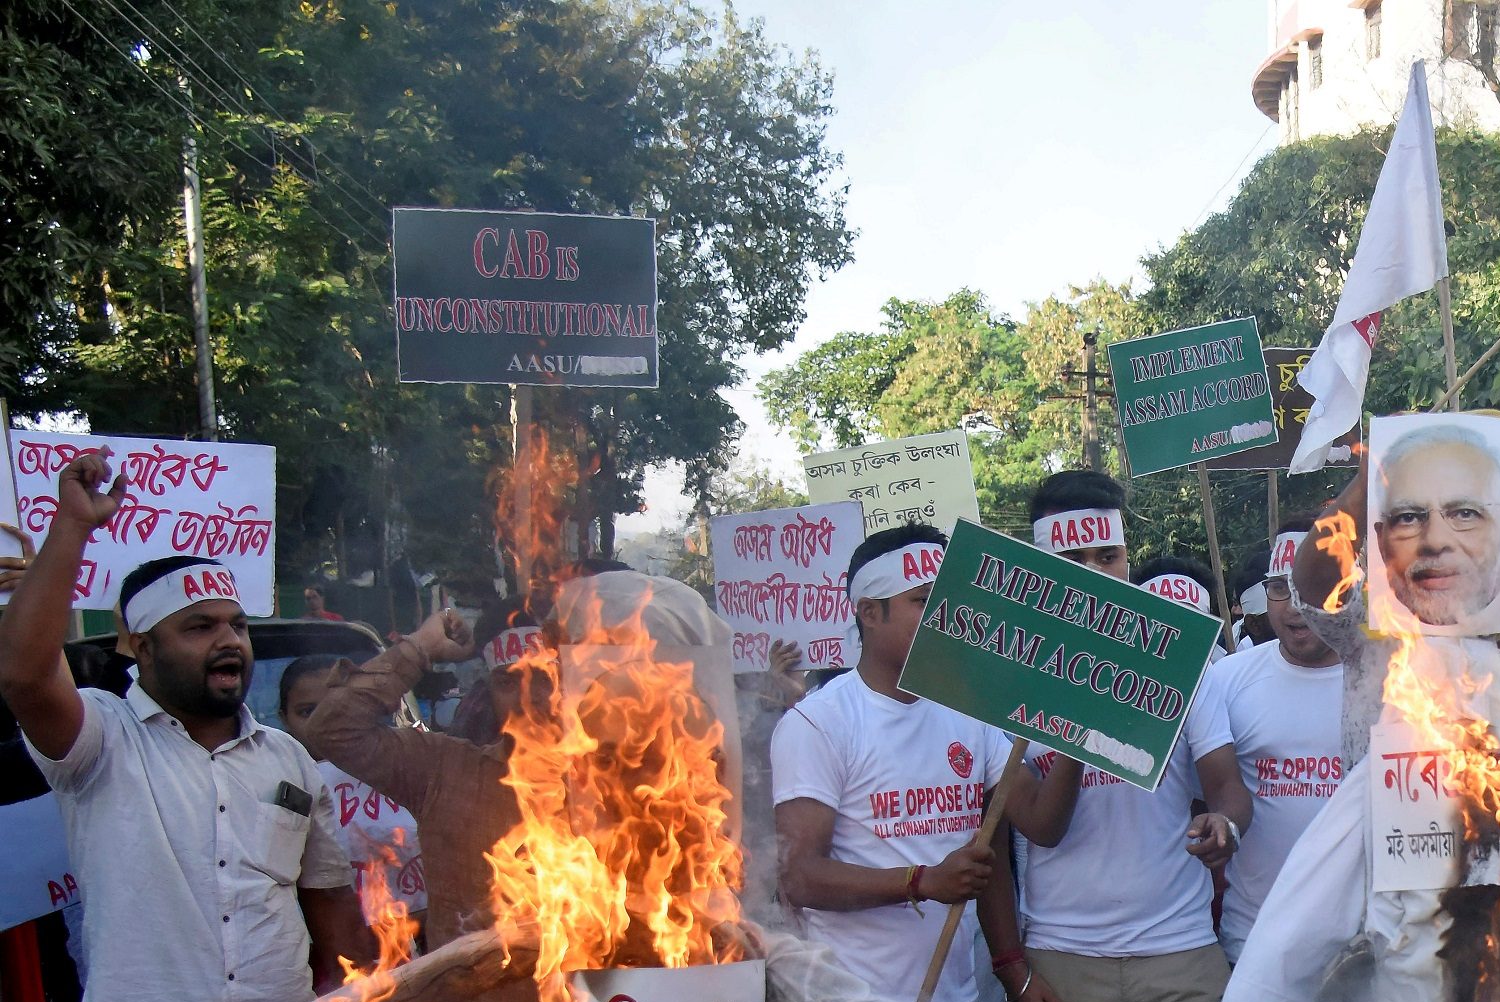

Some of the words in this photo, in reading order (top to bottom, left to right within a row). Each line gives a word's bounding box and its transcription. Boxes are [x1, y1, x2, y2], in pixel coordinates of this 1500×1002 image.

[473, 227, 550, 279] CAB
[556, 246, 580, 281] IS
[397, 297, 655, 337] UNCONSTITUTIONAL
[1130, 336, 1245, 383] IMPLEMENT
[1123, 389, 1190, 427] ASSAM
[1191, 372, 1267, 411] ACCORD
[805, 461, 847, 479] অসম
[850, 451, 901, 477] চুক্তিক
[848, 484, 881, 502] কৰা
[888, 477, 922, 496] কেব
[733, 525, 776, 562] অসম
[780, 513, 836, 569] অবৈধ
[1051, 516, 1111, 549] AASU
[971, 553, 1181, 661] IMPLEMENT
[923, 598, 1046, 669] ASSAM
[1040, 643, 1184, 722] ACCORD
[1255, 758, 1279, 780] WE
[1282, 756, 1343, 780] OPPOS
[870, 790, 901, 819] WE
[906, 784, 963, 816] OPPOSE
[1270, 782, 1313, 797] GUWAHATI
[875, 823, 892, 838] ALL
[894, 818, 937, 837] GUWAHATI
[1386, 826, 1407, 863] মই
[1408, 820, 1456, 859] অসমীয়া
